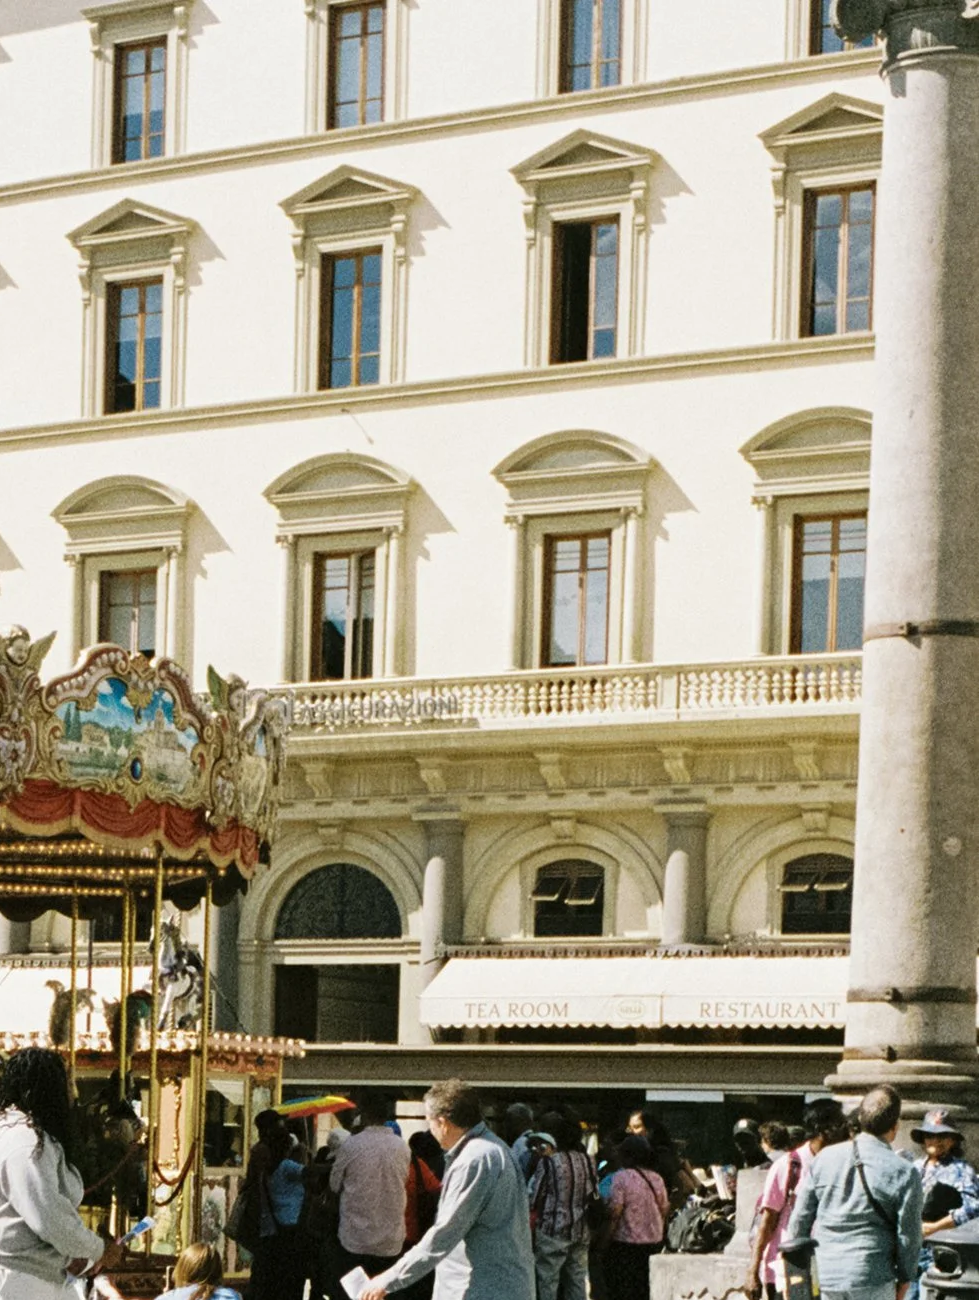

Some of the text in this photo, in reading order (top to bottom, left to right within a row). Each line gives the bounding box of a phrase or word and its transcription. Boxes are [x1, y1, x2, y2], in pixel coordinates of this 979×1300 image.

[464, 1002, 569, 1019] TEA ROOM
[699, 1002, 840, 1018] RESTAURANT
